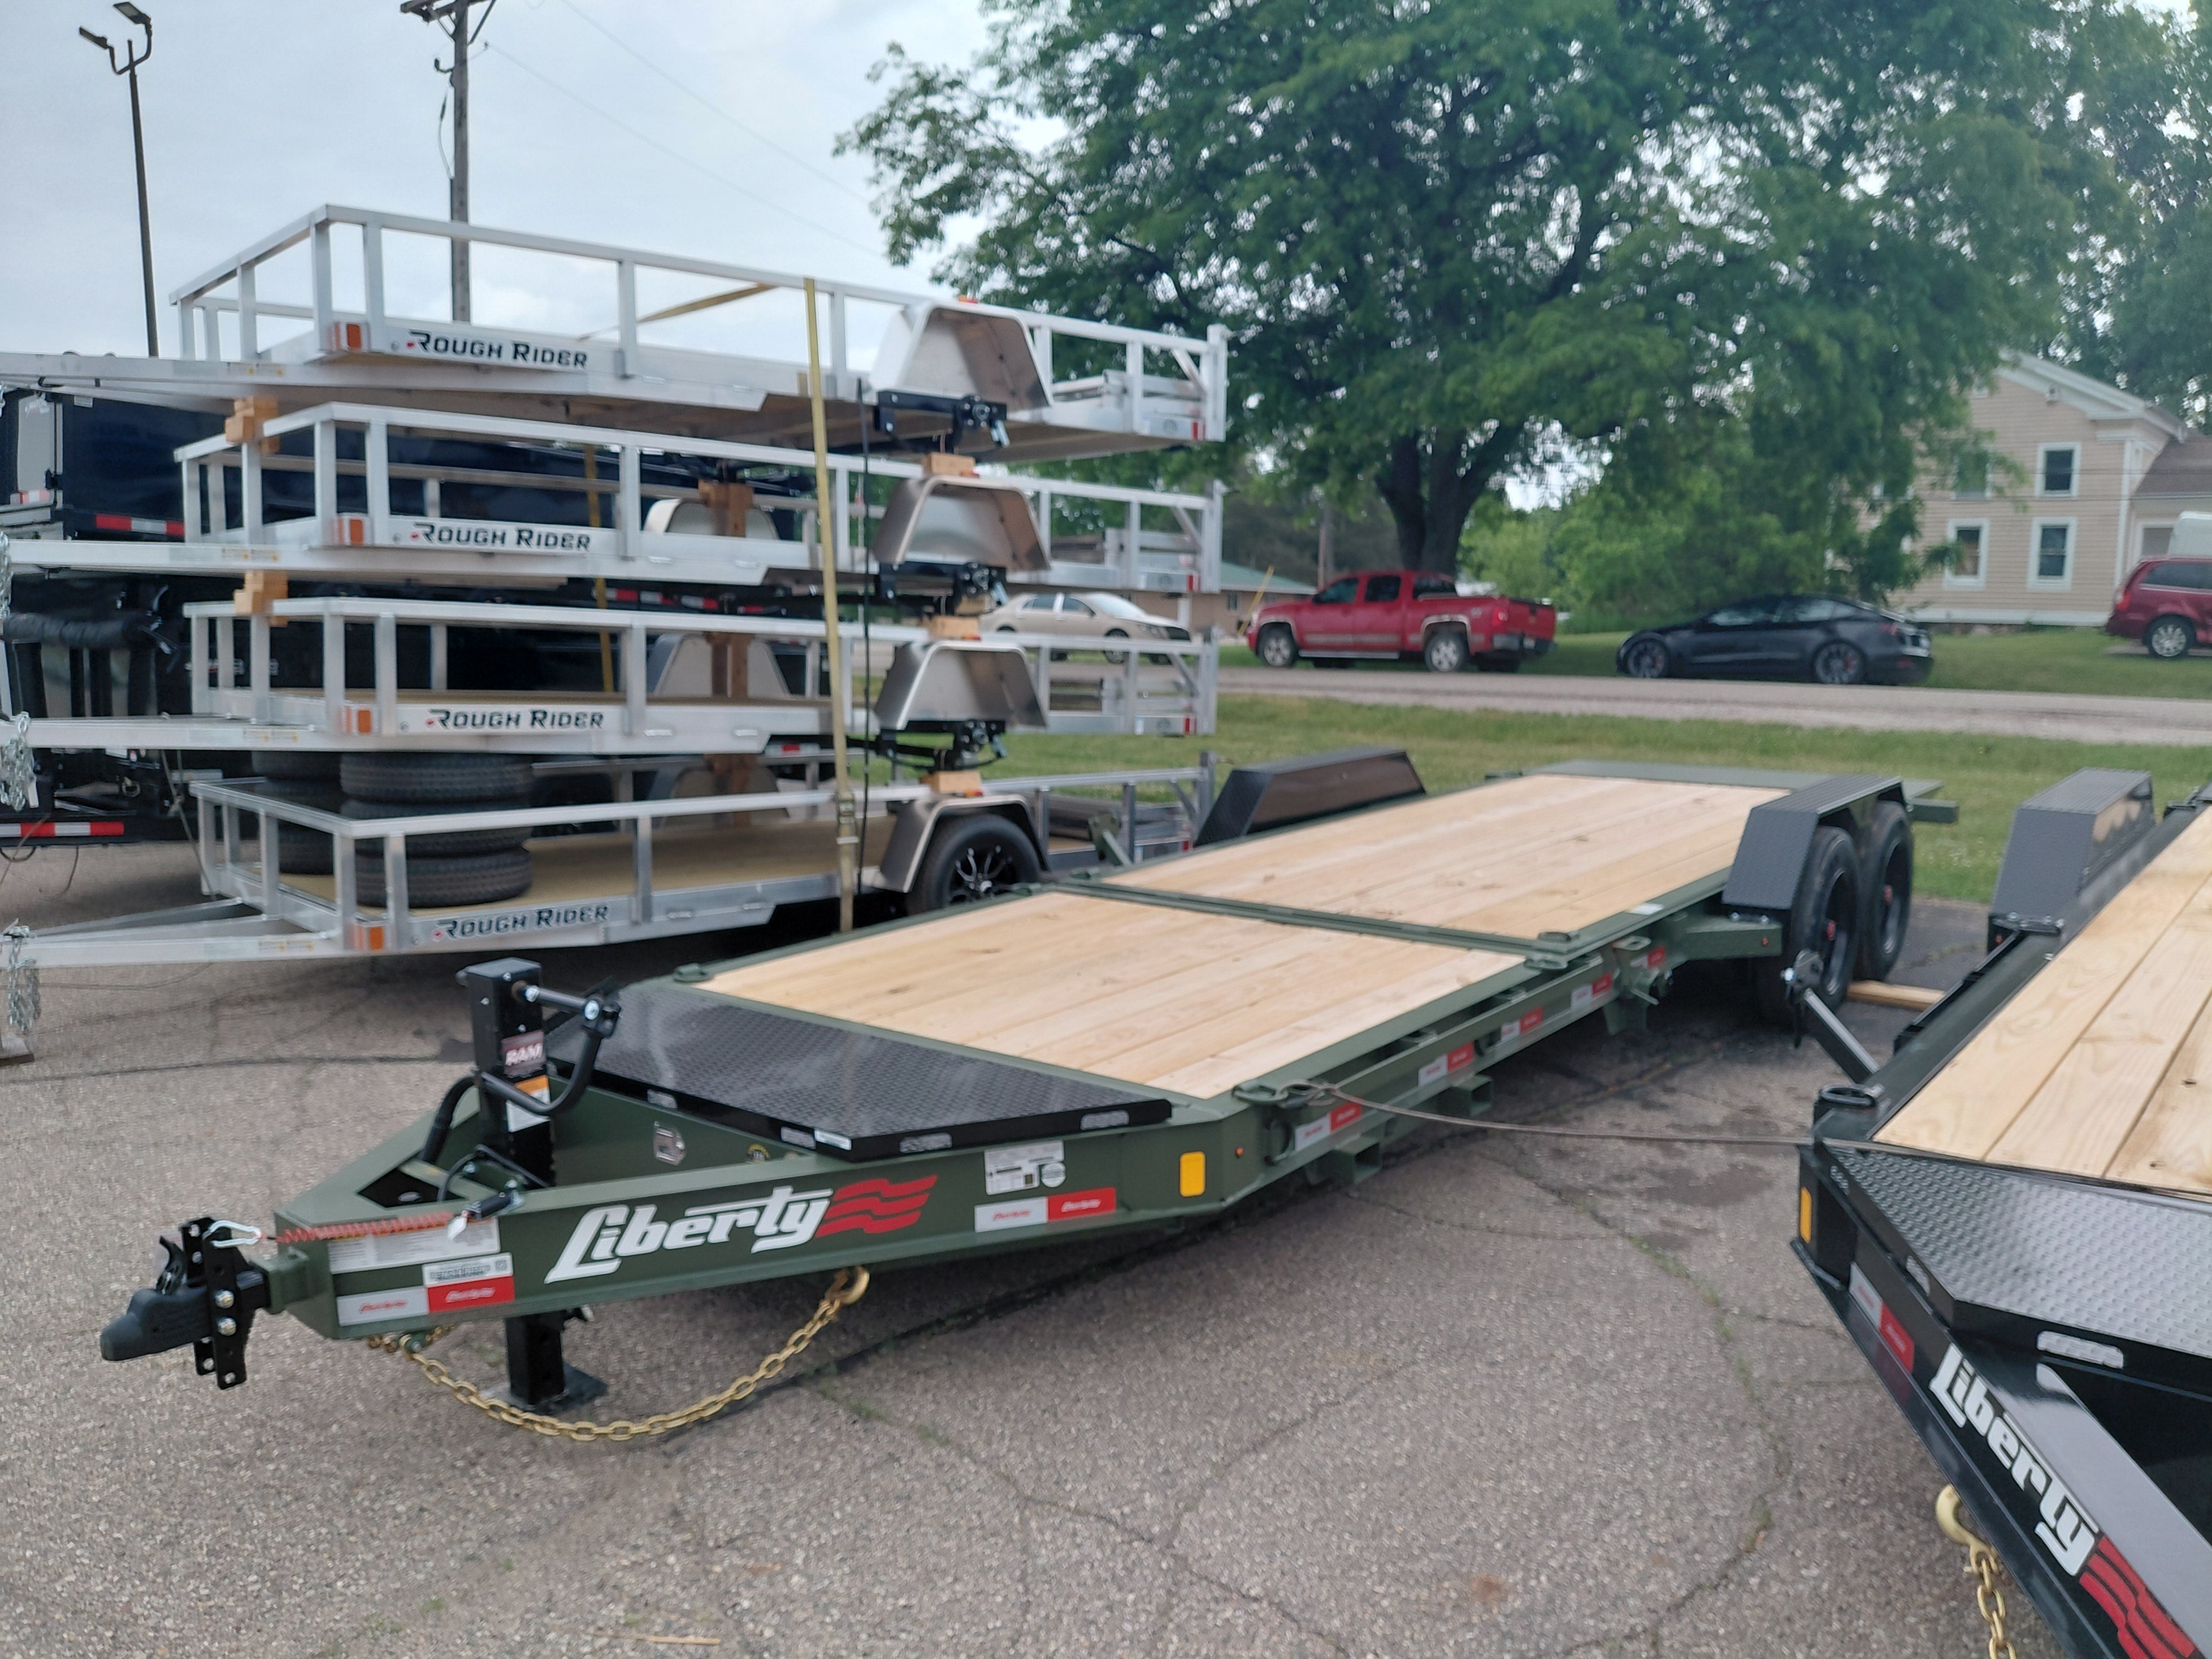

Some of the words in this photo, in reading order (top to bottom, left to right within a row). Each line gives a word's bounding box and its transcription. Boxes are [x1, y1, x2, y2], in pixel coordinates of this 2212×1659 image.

[408, 329, 502, 359] ROUGH
[512, 342, 588, 368] RIDER
[413, 523, 507, 546] ROUGH
[515, 529, 590, 551] RIDER
[429, 709, 520, 730] ROUGH
[530, 710, 604, 729] RIDER
[436, 916, 526, 938] ROUGH
[536, 905, 609, 927] RIDER
[544, 1185, 833, 1284] Liberty
[1928, 1342, 2099, 1576] Liberty
